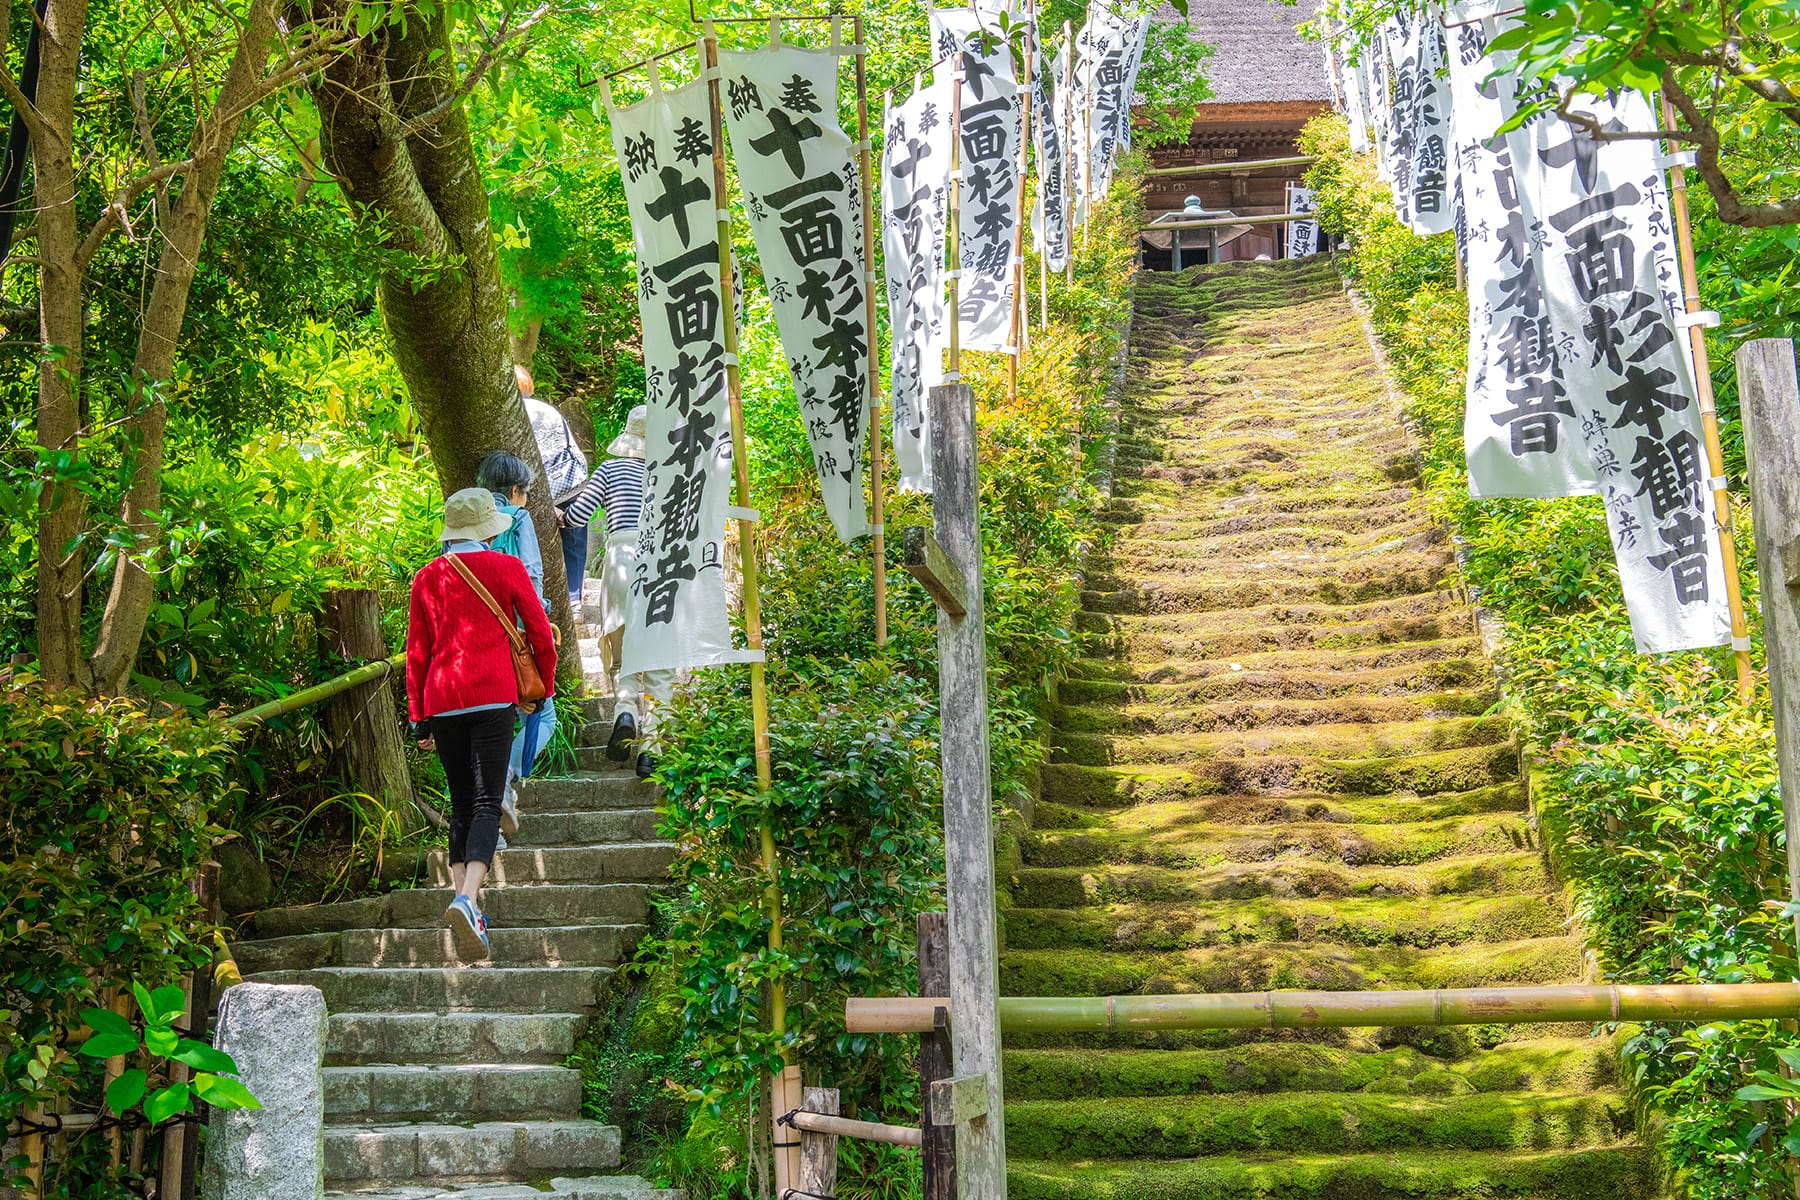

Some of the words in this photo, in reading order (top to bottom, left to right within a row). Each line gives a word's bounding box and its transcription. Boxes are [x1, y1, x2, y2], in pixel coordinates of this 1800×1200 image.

[623, 116, 713, 184] 奉納
[727, 73, 822, 122] 奉納
[643, 166, 725, 628] 十一面杉本観音
[1536, 110, 1710, 606] 十一面杉本観音
